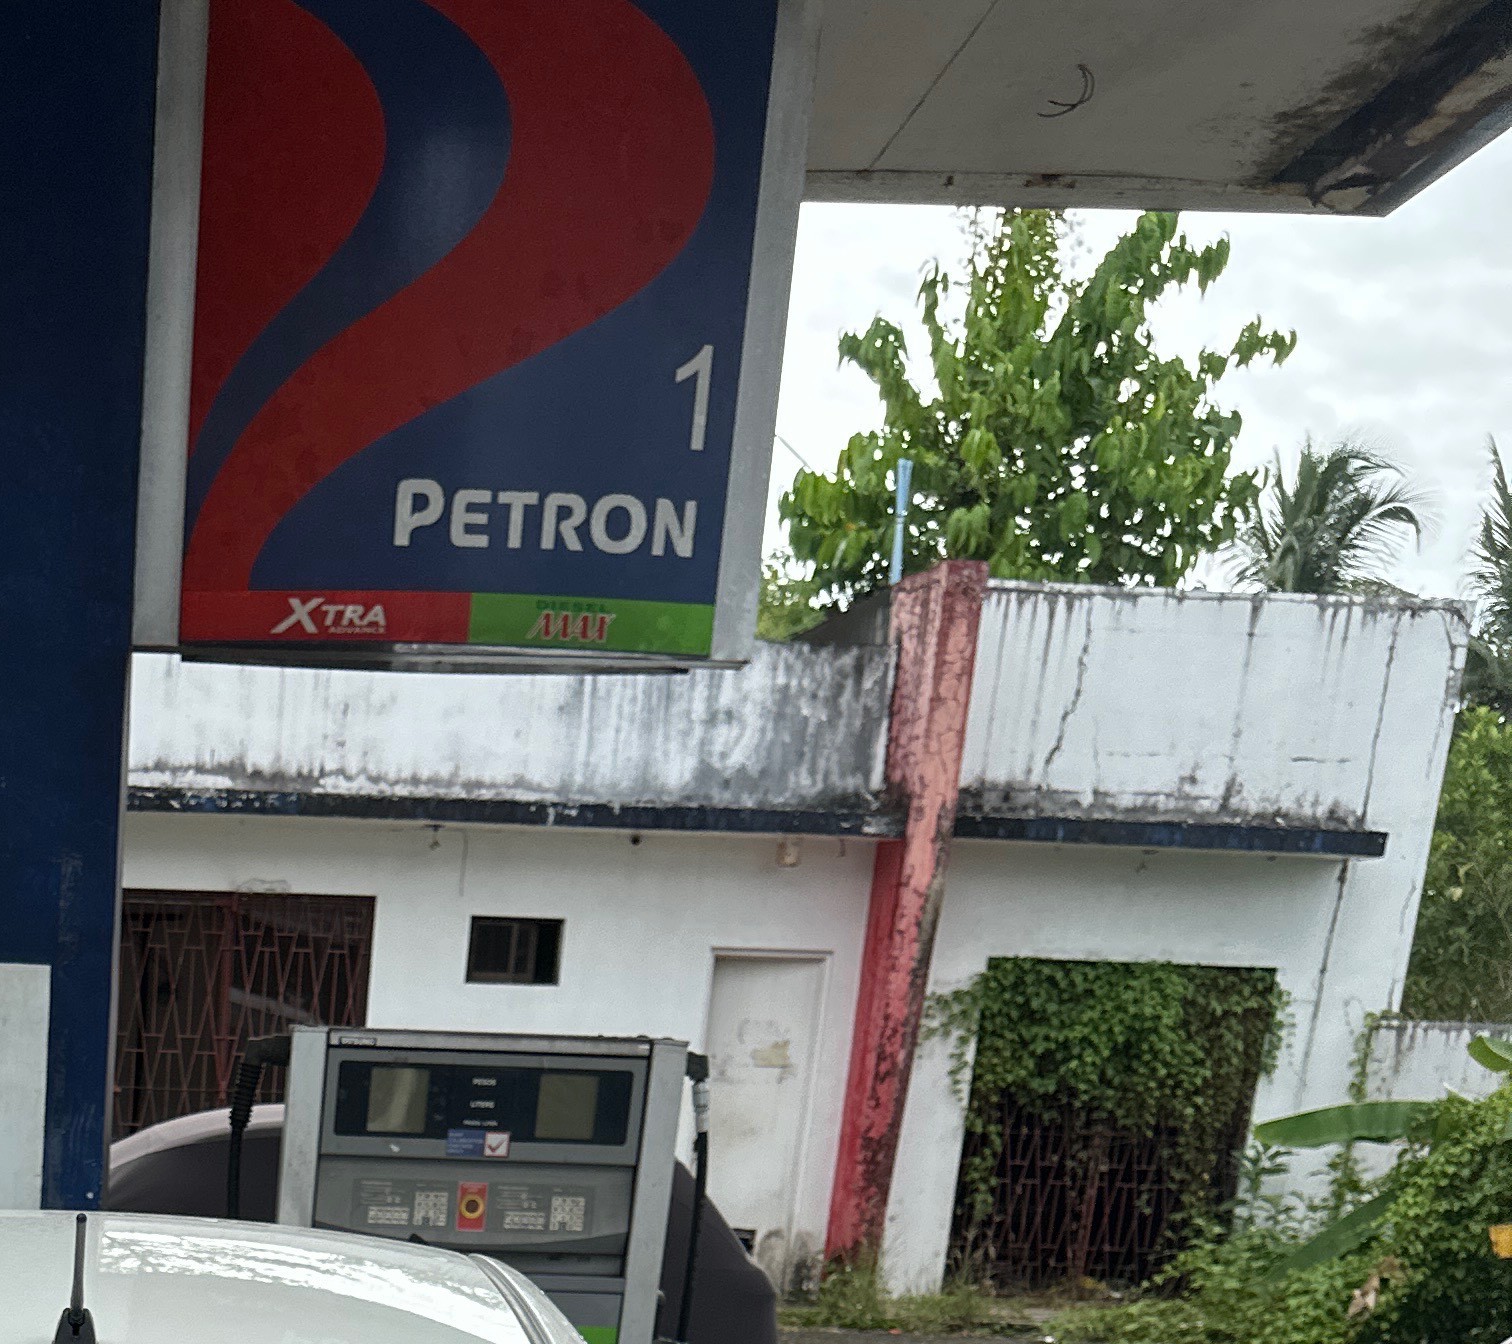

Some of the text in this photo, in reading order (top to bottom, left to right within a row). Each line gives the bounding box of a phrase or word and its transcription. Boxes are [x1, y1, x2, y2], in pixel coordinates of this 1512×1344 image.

[674, 344, 715, 452] 1
[392, 478, 698, 559] PETRON
[269, 597, 387, 634] XTRA
[525, 609, 617, 641] MAX
